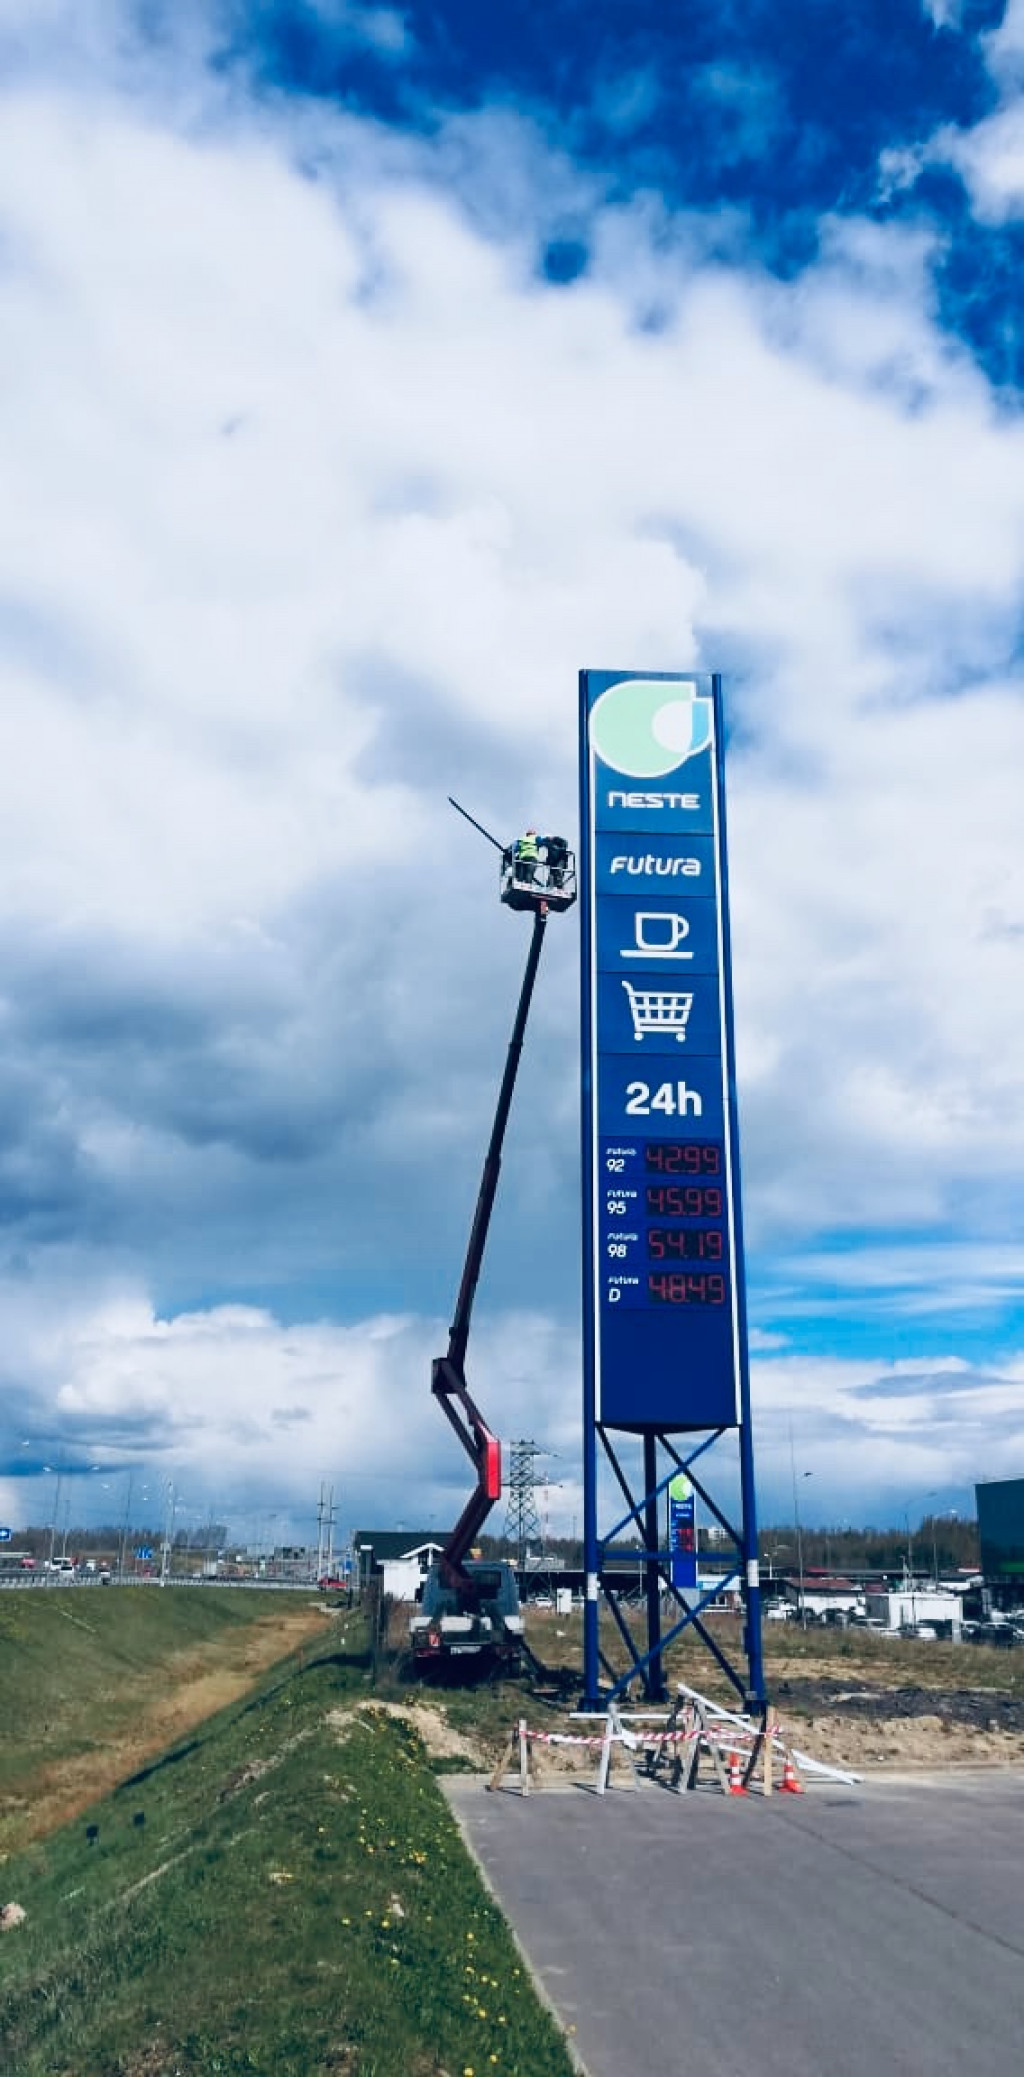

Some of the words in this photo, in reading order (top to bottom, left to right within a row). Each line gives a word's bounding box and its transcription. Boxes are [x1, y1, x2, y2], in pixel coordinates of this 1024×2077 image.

[608, 791, 700, 809] NESTE
[625, 1081, 703, 1116] 24h
[606, 1158, 625, 1172] 92
[607, 1200, 626, 1214] 95
[607, 1243, 627, 1257] 98
[608, 1287, 621, 1303] D
